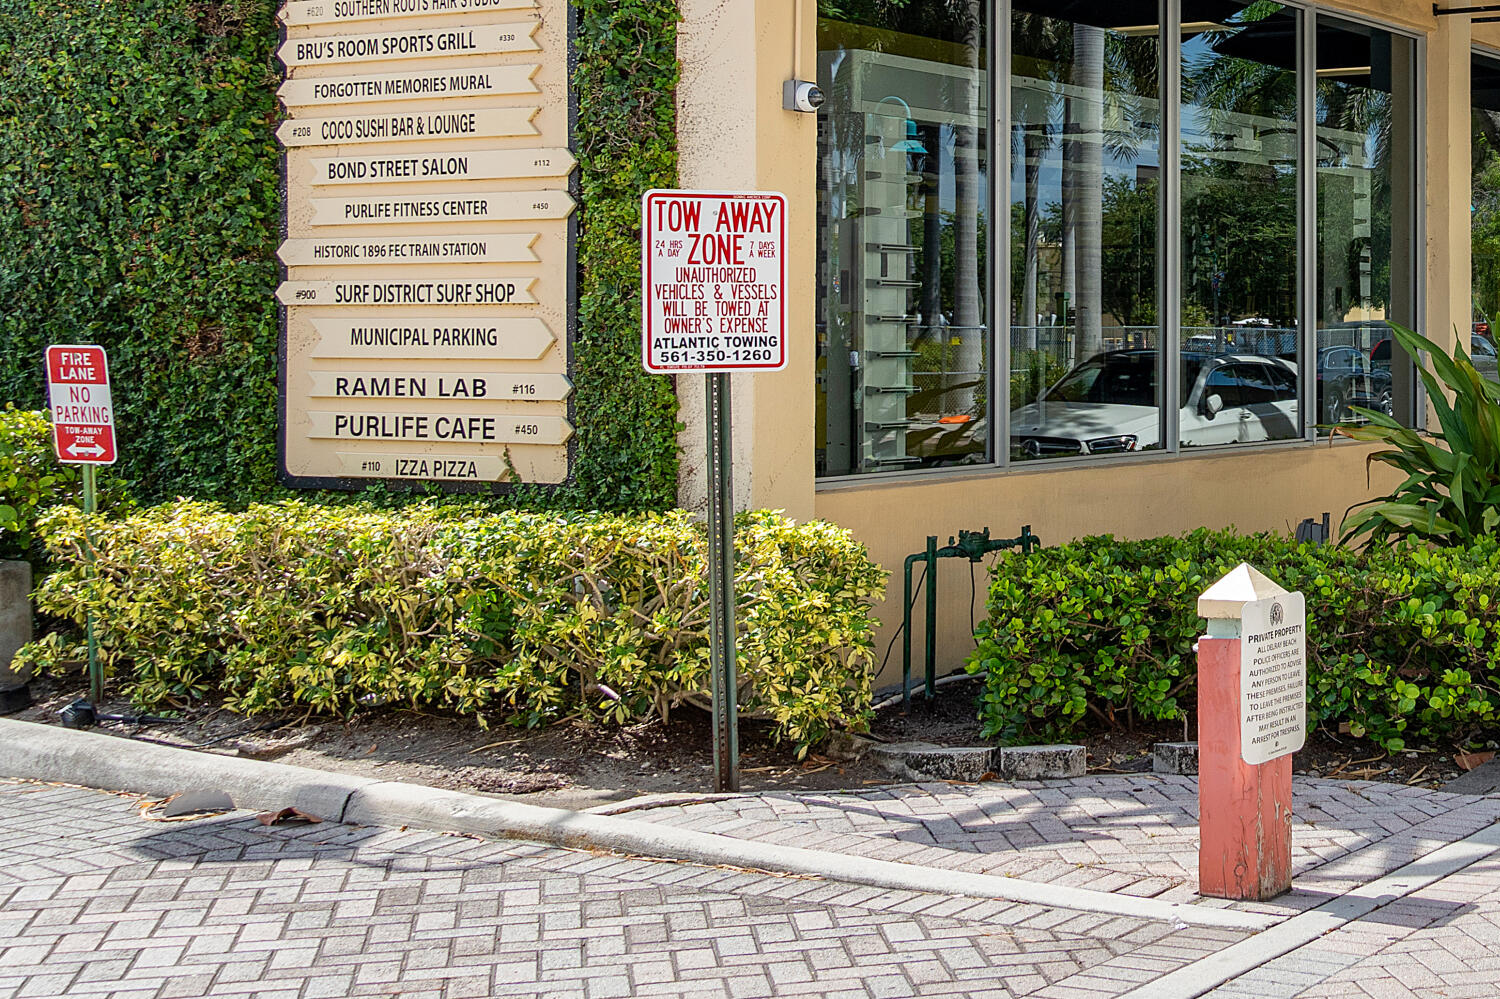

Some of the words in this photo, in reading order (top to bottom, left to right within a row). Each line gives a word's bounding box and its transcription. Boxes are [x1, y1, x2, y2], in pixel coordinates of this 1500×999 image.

[334, 0, 389, 18] SOUTHERN
[297, 42, 335, 60] BRU'S
[337, 38, 379, 57] ROOM
[382, 34, 433, 55] SPORTS
[437, 30, 476, 51] GRILL
[499, 34, 515, 42] #330
[314, 80, 382, 99] FORGOTTEN
[385, 77, 446, 96] MEMORIES
[450, 74, 493, 91] MURAL
[292, 126, 311, 137] #208
[321, 120, 353, 140] COCO
[355, 118, 389, 138] SUSHI
[391, 116, 414, 137] BAR
[416, 116, 425, 135] &
[428, 113, 476, 134] LOUNGE
[328, 162, 367, 180] BOND
[370, 159, 419, 177] STREET
[422, 157, 468, 175] SALON
[534, 159, 550, 167] #112
[345, 201, 391, 218] PURLIFE
[393, 201, 440, 217] FITNESS
[442, 200, 488, 216] CENTER
[655, 200, 702, 232] TOW
[715, 202, 777, 233] AWAY
[314, 244, 359, 258] HISTORIC
[362, 244, 387, 257] 1896
[389, 243, 407, 257] FEC
[408, 243, 440, 257] TRAIN
[442, 242, 487, 256] STATION
[655, 240, 665, 249] 24
[670, 240, 683, 249] HRS
[658, 249, 664, 257] A
[667, 249, 681, 258] DAY
[688, 234, 745, 265] ZONE
[750, 241, 755, 250] 7
[758, 241, 775, 250] DAYS
[749, 250, 754, 258] A
[758, 250, 776, 258] WEEK
[675, 267, 756, 283] UNAUTHORIZED
[296, 289, 316, 300] #900
[335, 284, 370, 303] SURF
[373, 284, 434, 303] DISTRICT
[437, 283, 474, 303] SURF
[475, 283, 515, 303] SHOP
[655, 284, 704, 300] VEHICLES
[714, 284, 723, 300] &
[731, 284, 777, 300] VESSELS
[663, 301, 687, 317] WILL
[695, 301, 708, 317] BE
[716, 301, 750, 317] TOWED
[757, 301, 769, 317] AT
[664, 317, 712, 334] OWNER'S
[720, 317, 768, 334] EXPENSE
[350, 328, 429, 346] MUNICIPAL
[433, 327, 498, 346] PARKING
[654, 337, 720, 349] ATLANTIC
[724, 336, 778, 348] TOWING
[60, 352, 92, 366] FIRE
[660, 350, 772, 363] 561-350-1260
[60, 367, 96, 380] LANE
[69, 386, 90, 403] NO
[336, 377, 427, 397] RAMEN
[438, 377, 487, 397] LAB
[512, 384, 536, 395] #116
[56, 405, 109, 423] PARKING
[65, 426, 103, 435] TOW-AWAY
[335, 415, 428, 438] PURLIFE
[435, 417, 496, 440] CAFE
[515, 425, 538, 435] #450
[75, 435, 95, 444] ZONE
[362, 461, 381, 471] #110
[395, 459, 430, 477] IZZA
[433, 460, 478, 478] PIZZA
[1248, 630, 1273, 643] PRIVATE
[1275, 624, 1302, 638] PROPERTY
[1267, 641, 1282, 652] DELRAY
[1283, 638, 1296, 647] BEACH
[1253, 655, 1271, 665] POLICE
[1271, 650, 1290, 661] OFFICERS
[1249, 664, 1280, 677] AUTHORIZED
[1281, 662, 1286, 670] TO
[1287, 658, 1302, 668] ADVISE
[1251, 680, 1264, 688] ANY
[1265, 675, 1281, 686] PERSON
[1282, 673, 1288, 681] TO
[1288, 669, 1300, 679] LEAVE
[1246, 690, 1265, 700] THESE
[1287, 680, 1303, 690] FAILURE
[1260, 700, 1273, 709] LEAVE
[1282, 691, 1302, 702] PREMISES
[1246, 713, 1265, 723] AFTER
[1266, 709, 1278, 719] BEING
[1279, 702, 1304, 714] INSTRUCTED
[1259, 723, 1269, 732] MAY
[1270, 719, 1284, 728] RESULT
[1290, 714, 1297, 722] AN
[1251, 733, 1270, 744] ARREST
[1271, 730, 1280, 739] FOR
